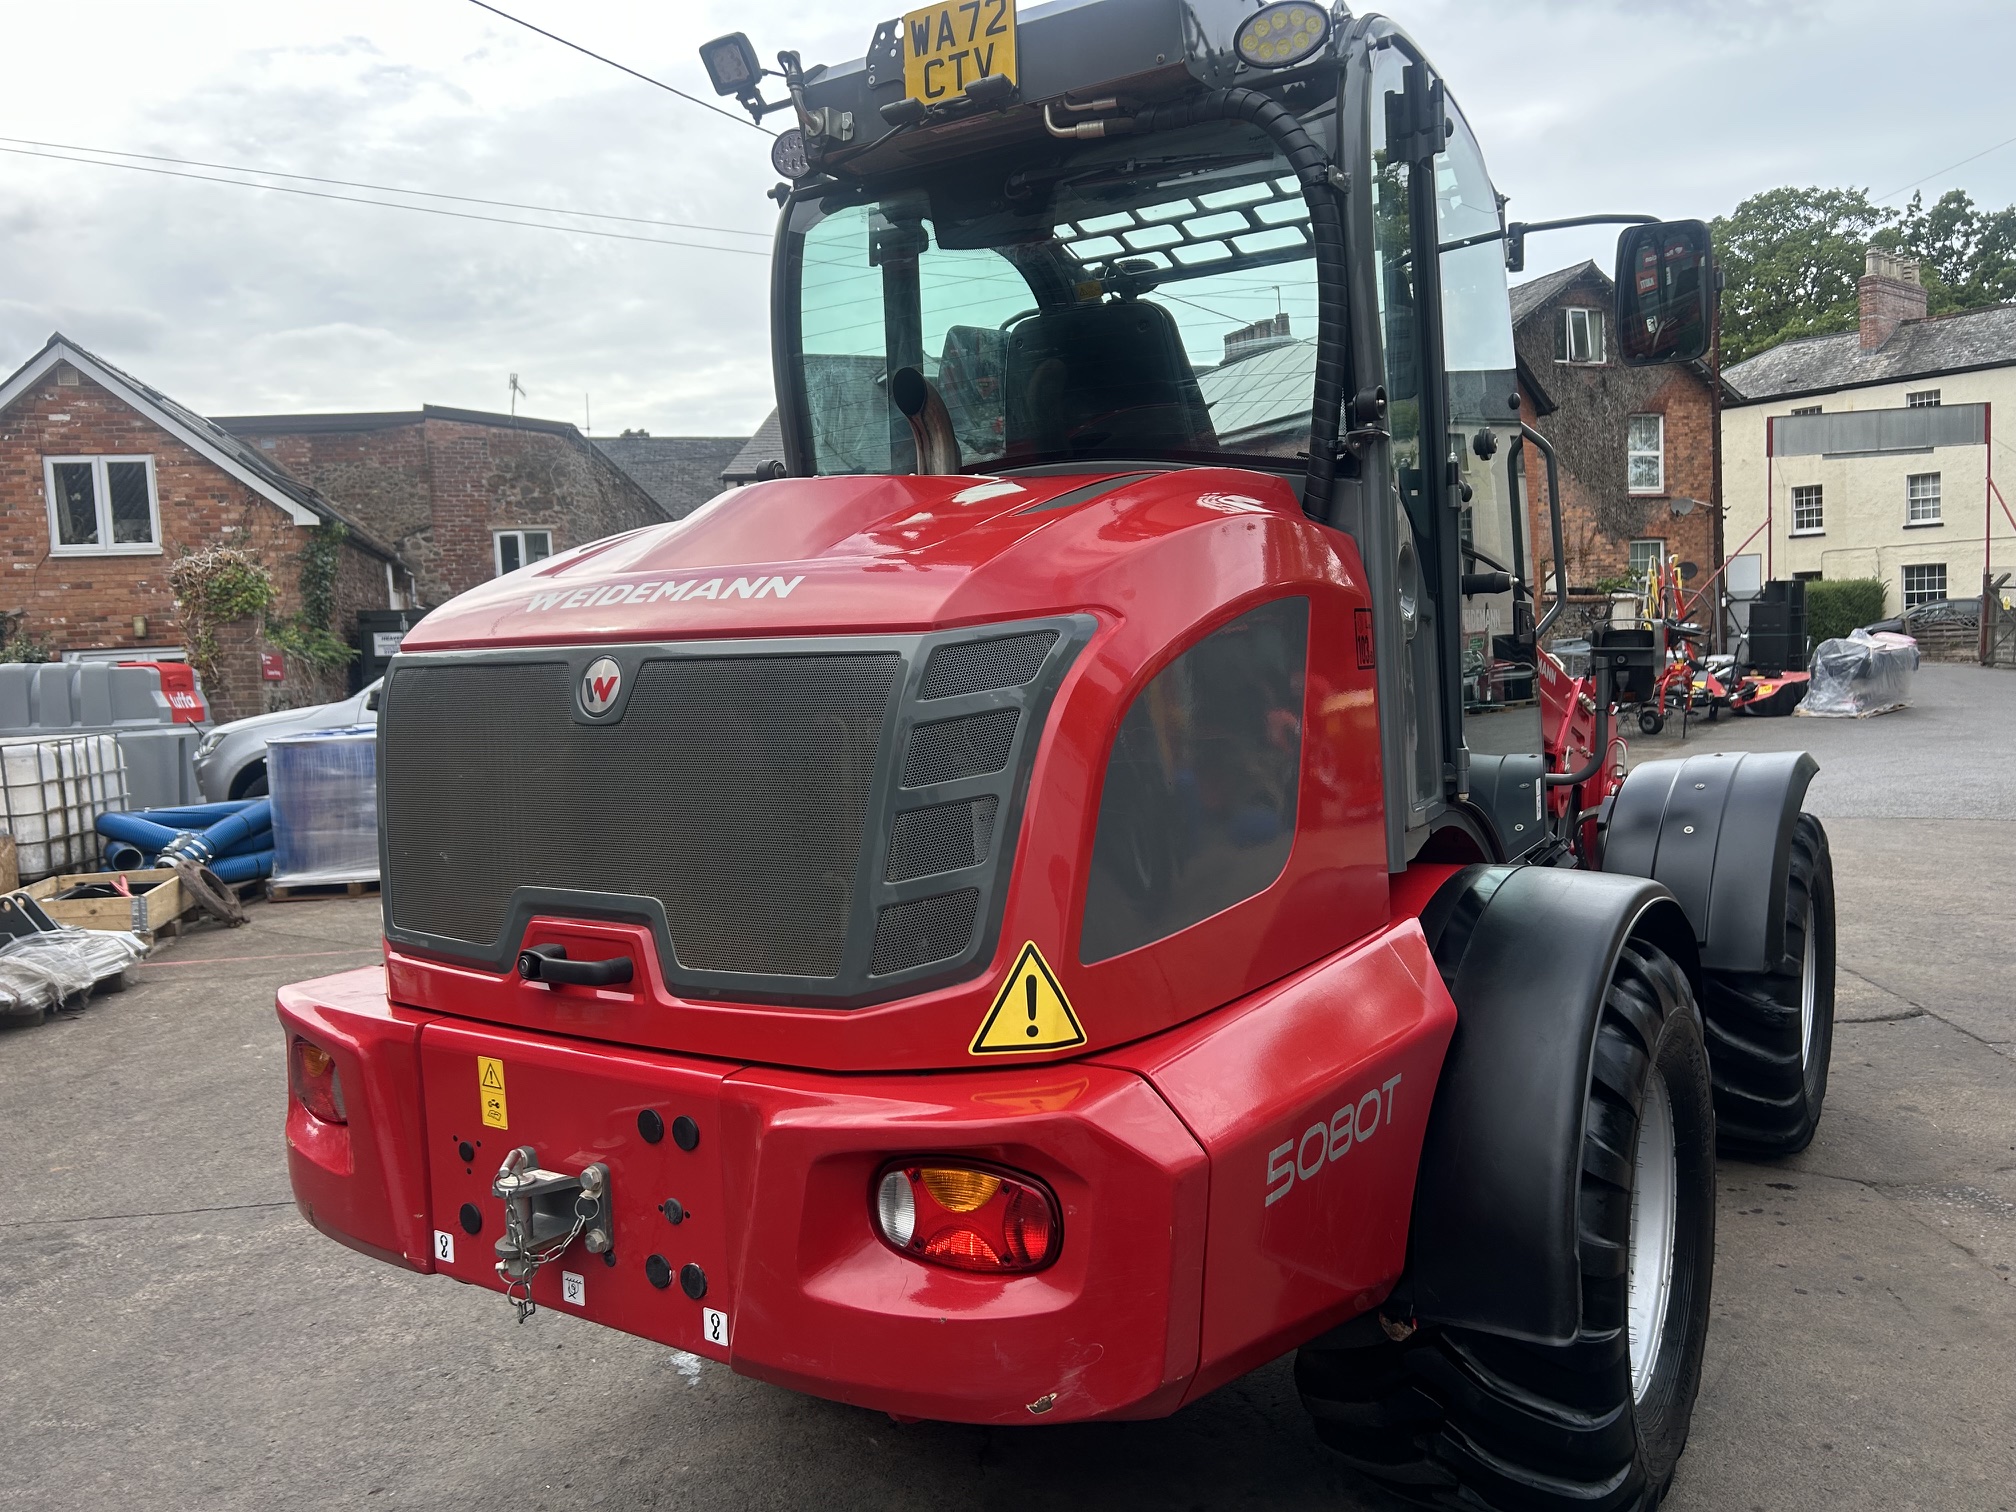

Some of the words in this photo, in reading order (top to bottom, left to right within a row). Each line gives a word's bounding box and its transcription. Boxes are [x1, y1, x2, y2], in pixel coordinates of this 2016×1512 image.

[910, 0, 1007, 58] WA72
[924, 42, 994, 98] CTV
[525, 575, 806, 613] WEIDEMANN
[169, 691, 196, 709] tuffa
[1264, 1072, 1402, 1208] 5080T
